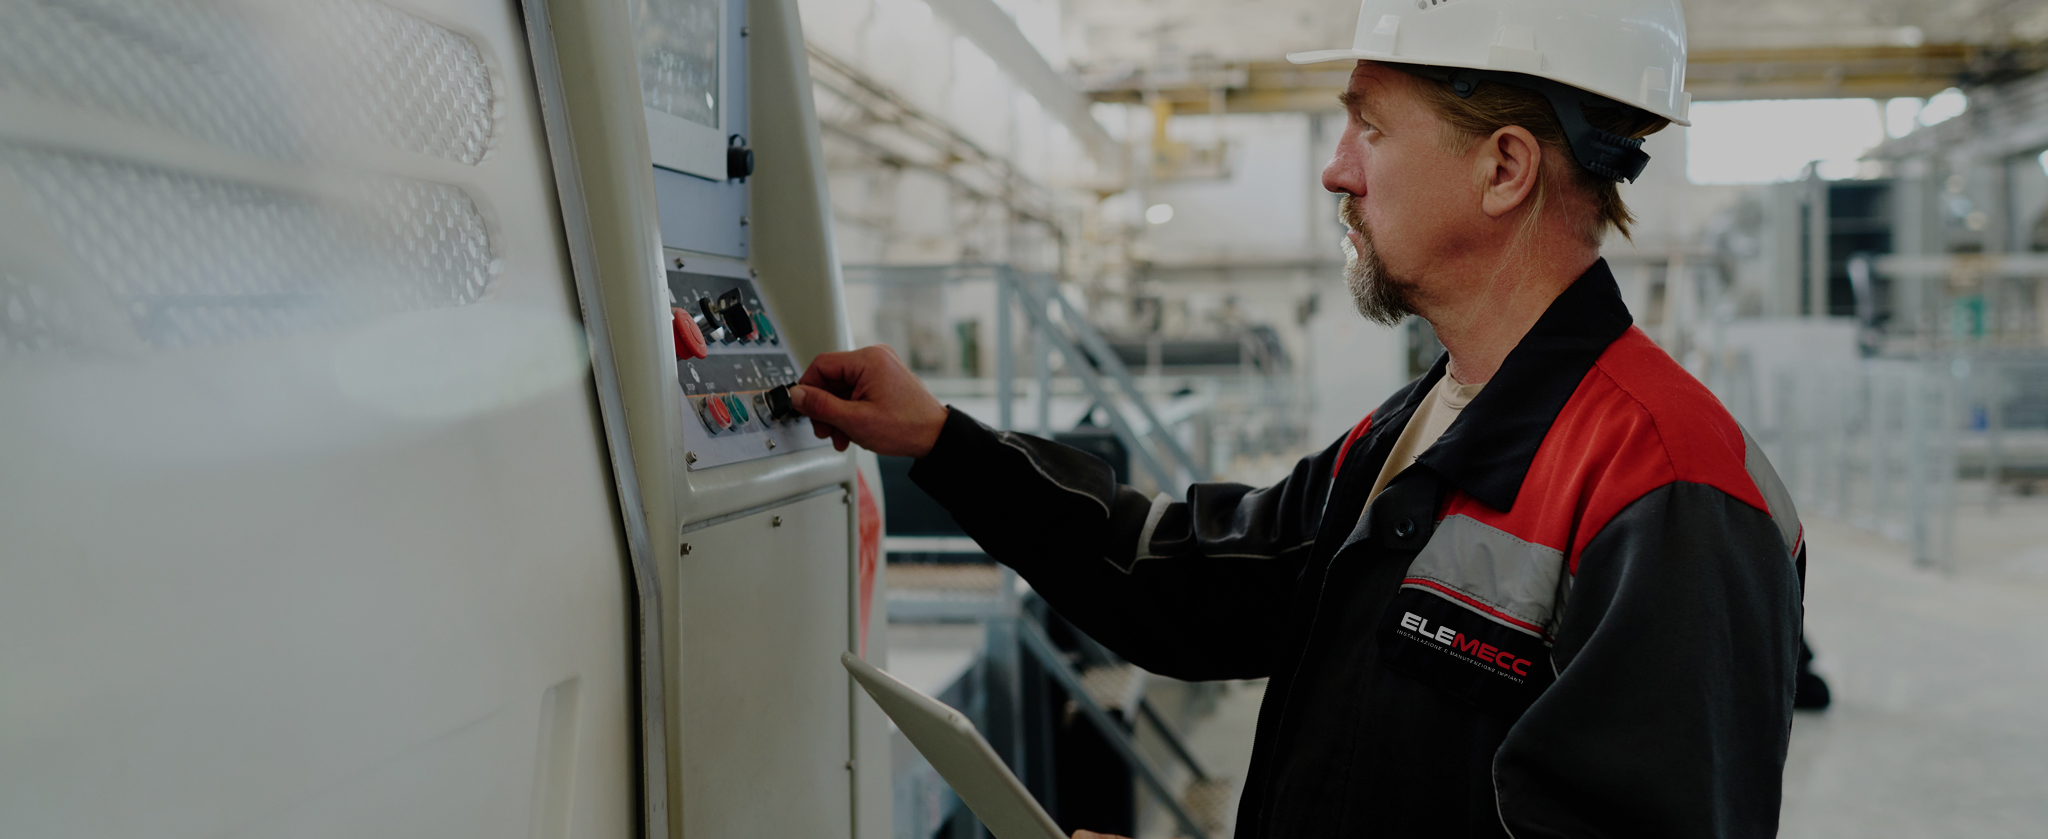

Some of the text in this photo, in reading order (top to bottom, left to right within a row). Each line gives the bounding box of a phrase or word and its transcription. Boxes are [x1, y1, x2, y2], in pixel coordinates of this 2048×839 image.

[1396, 629, 1442, 651] INSTALLAZIONE
[1449, 651, 1496, 673] MANUTENZIONE
[1497, 670, 1524, 684] IMPIANTI
[1401, 612, 1531, 676] ELEMECC
